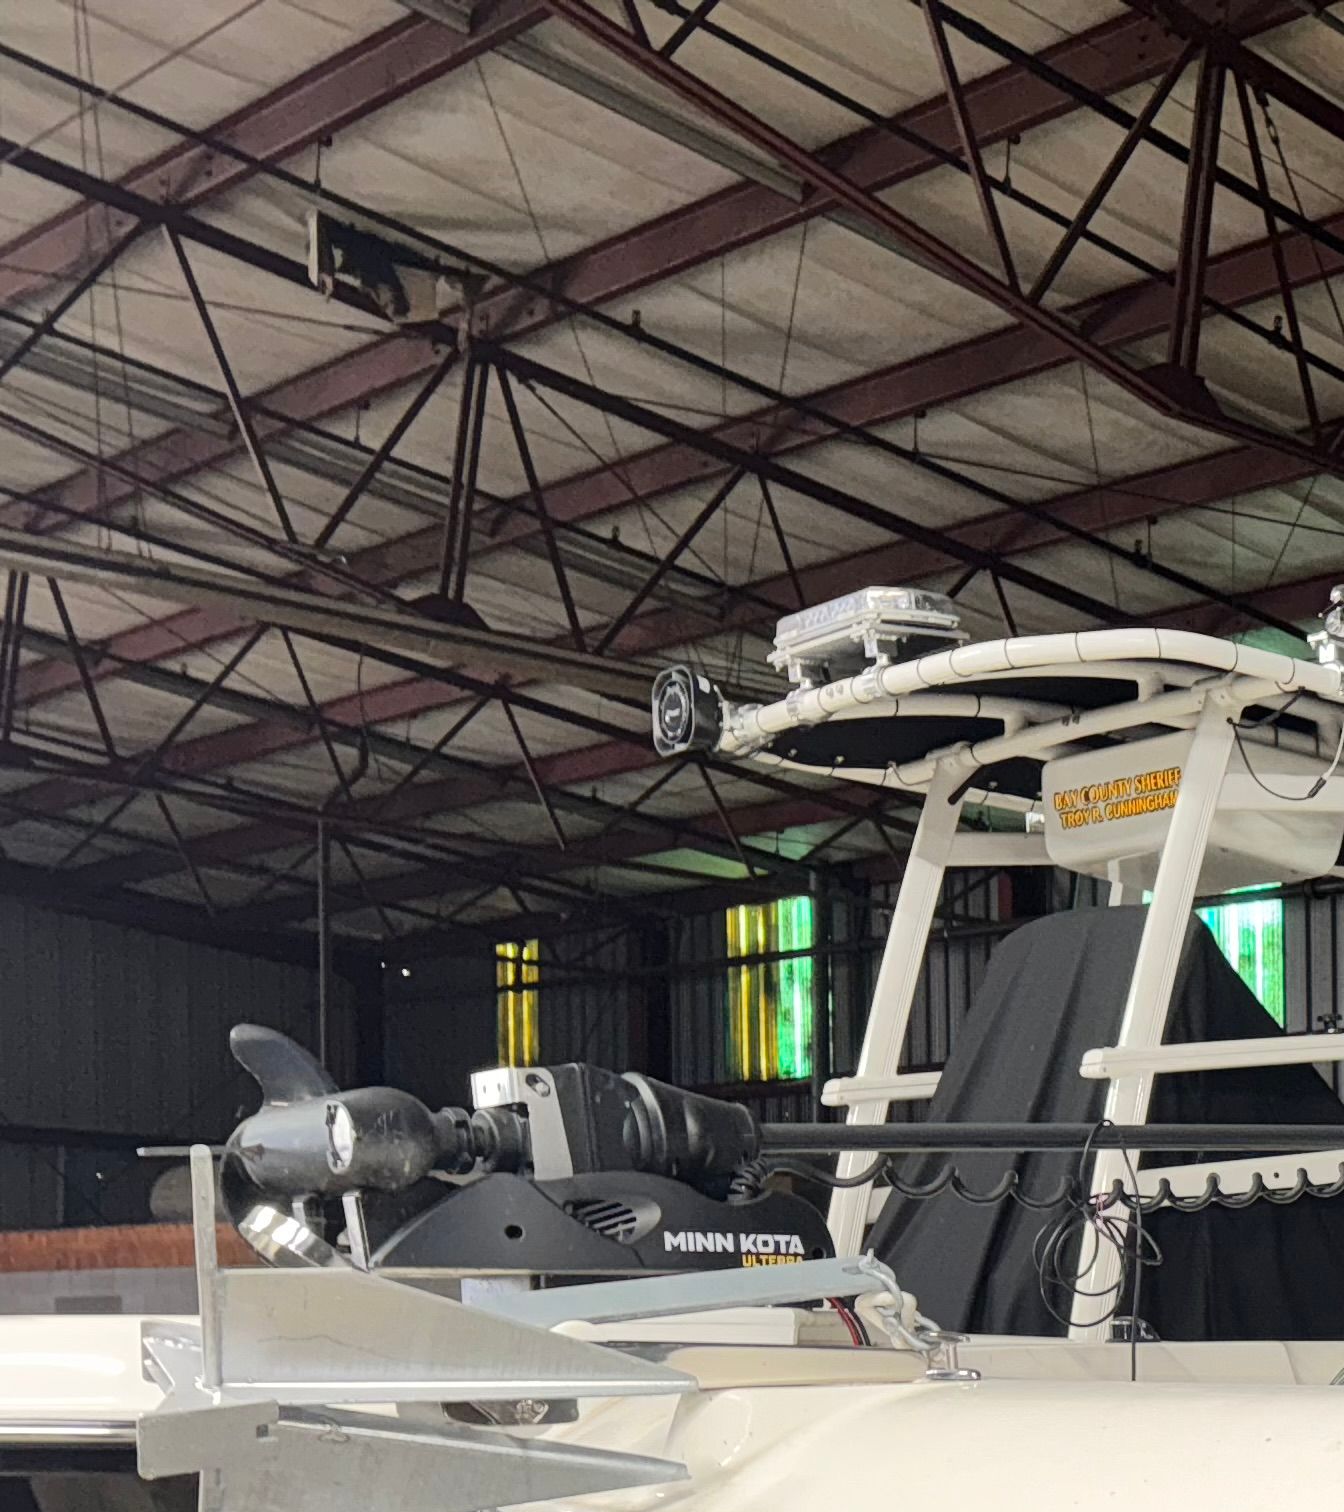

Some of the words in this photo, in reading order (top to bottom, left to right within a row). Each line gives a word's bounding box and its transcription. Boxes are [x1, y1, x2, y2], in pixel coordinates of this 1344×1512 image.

[1054, 787, 1080, 811] BAY
[1080, 777, 1132, 806] COUNTY
[1134, 766, 1182, 795] SHERIFF
[1060, 807, 1091, 830] TROY
[1091, 806, 1104, 824] R.
[1104, 790, 1180, 822] CUNNINGHAM
[663, 1230, 735, 1253] MINN
[739, 1232, 806, 1255] KOTA
